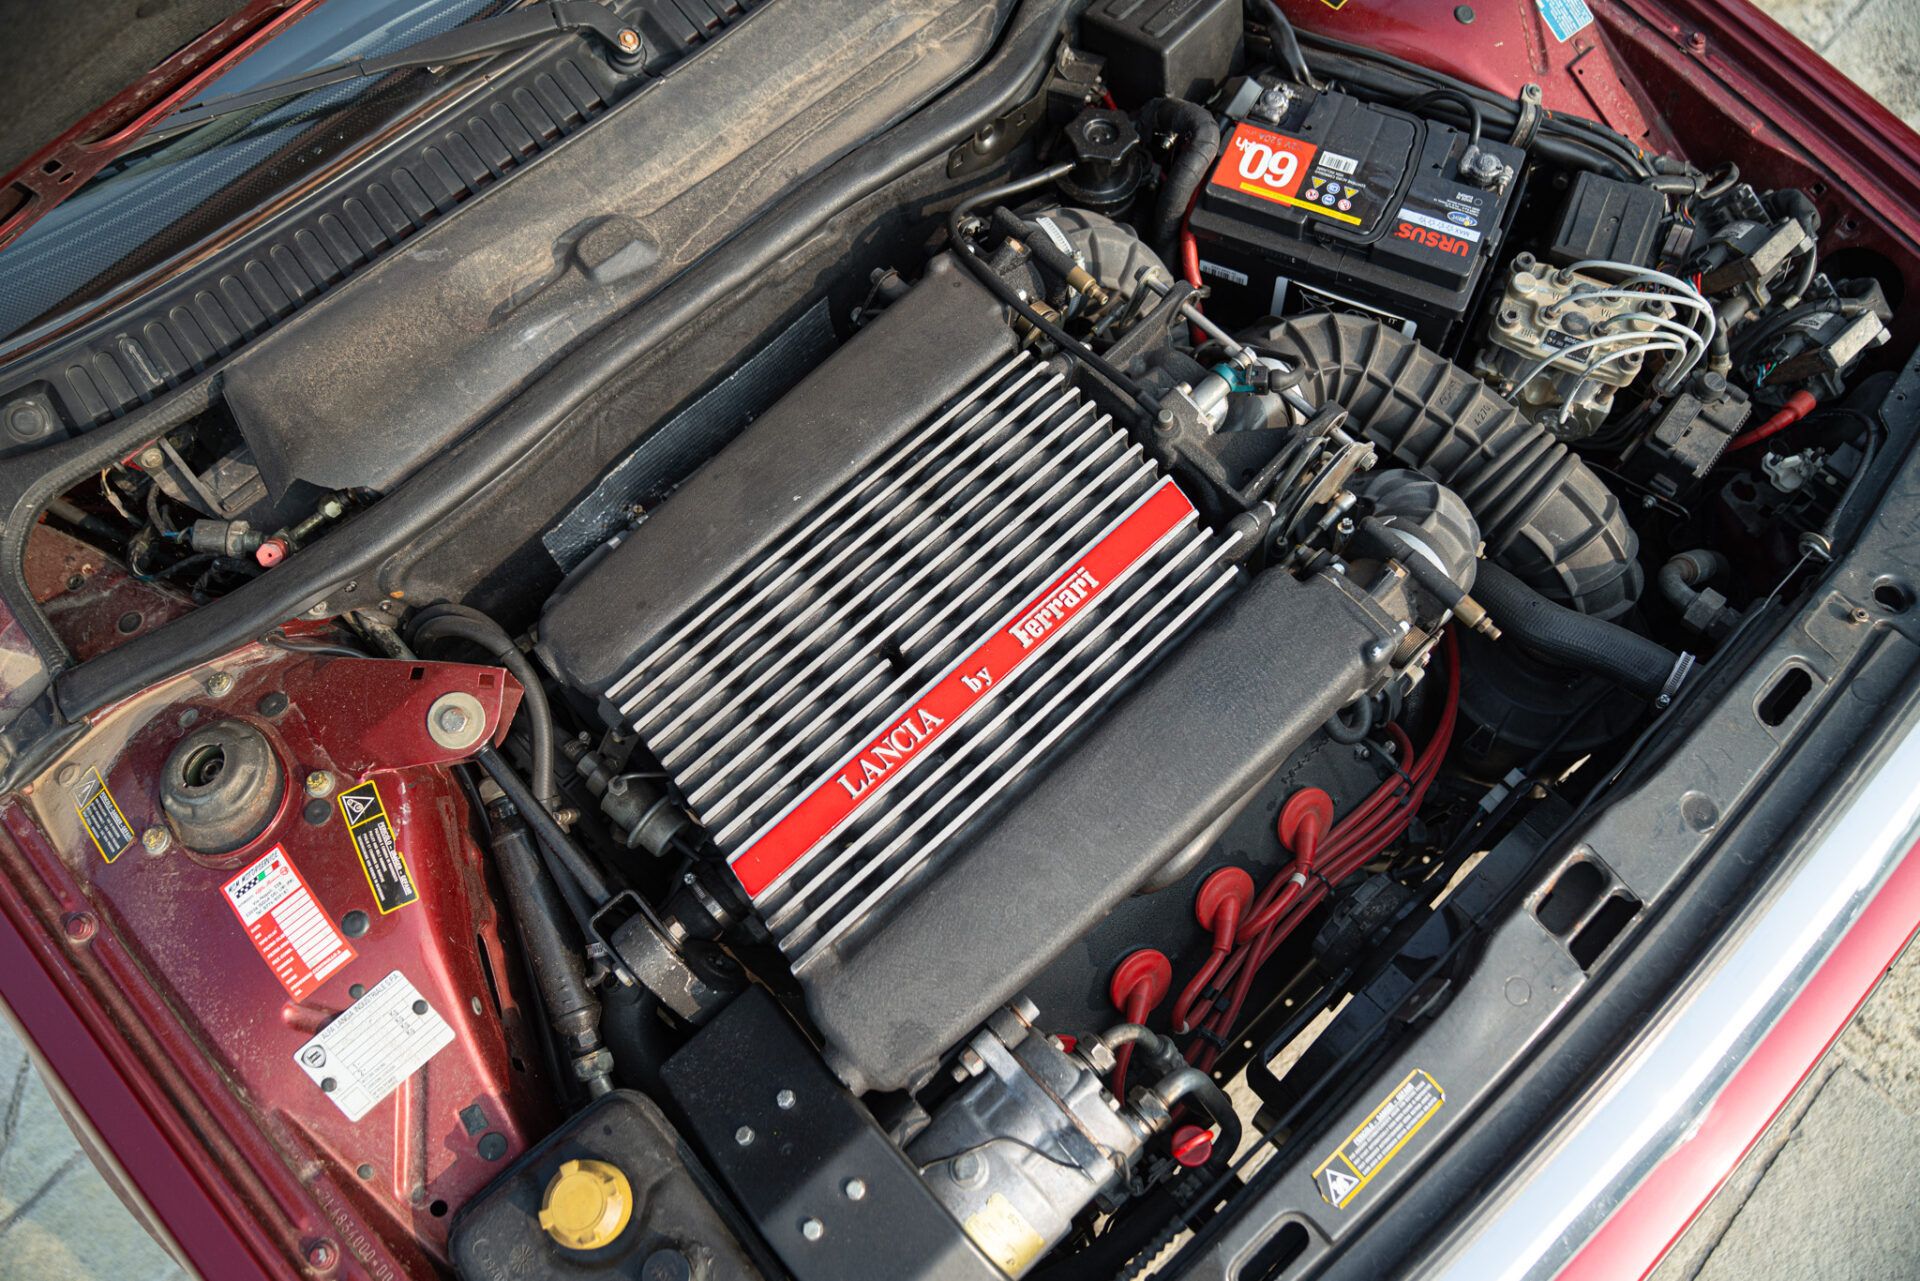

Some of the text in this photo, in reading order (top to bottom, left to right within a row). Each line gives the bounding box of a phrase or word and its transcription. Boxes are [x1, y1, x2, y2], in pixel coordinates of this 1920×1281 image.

[1396, 222, 1468, 257] URSUS
[836, 566, 1100, 800] LANCIA by Ferrari
[320, 1025, 336, 1039] ALFA
[333, 1009, 355, 1028] LANCIA
[352, 982, 387, 1012] INDUSTRIALE
